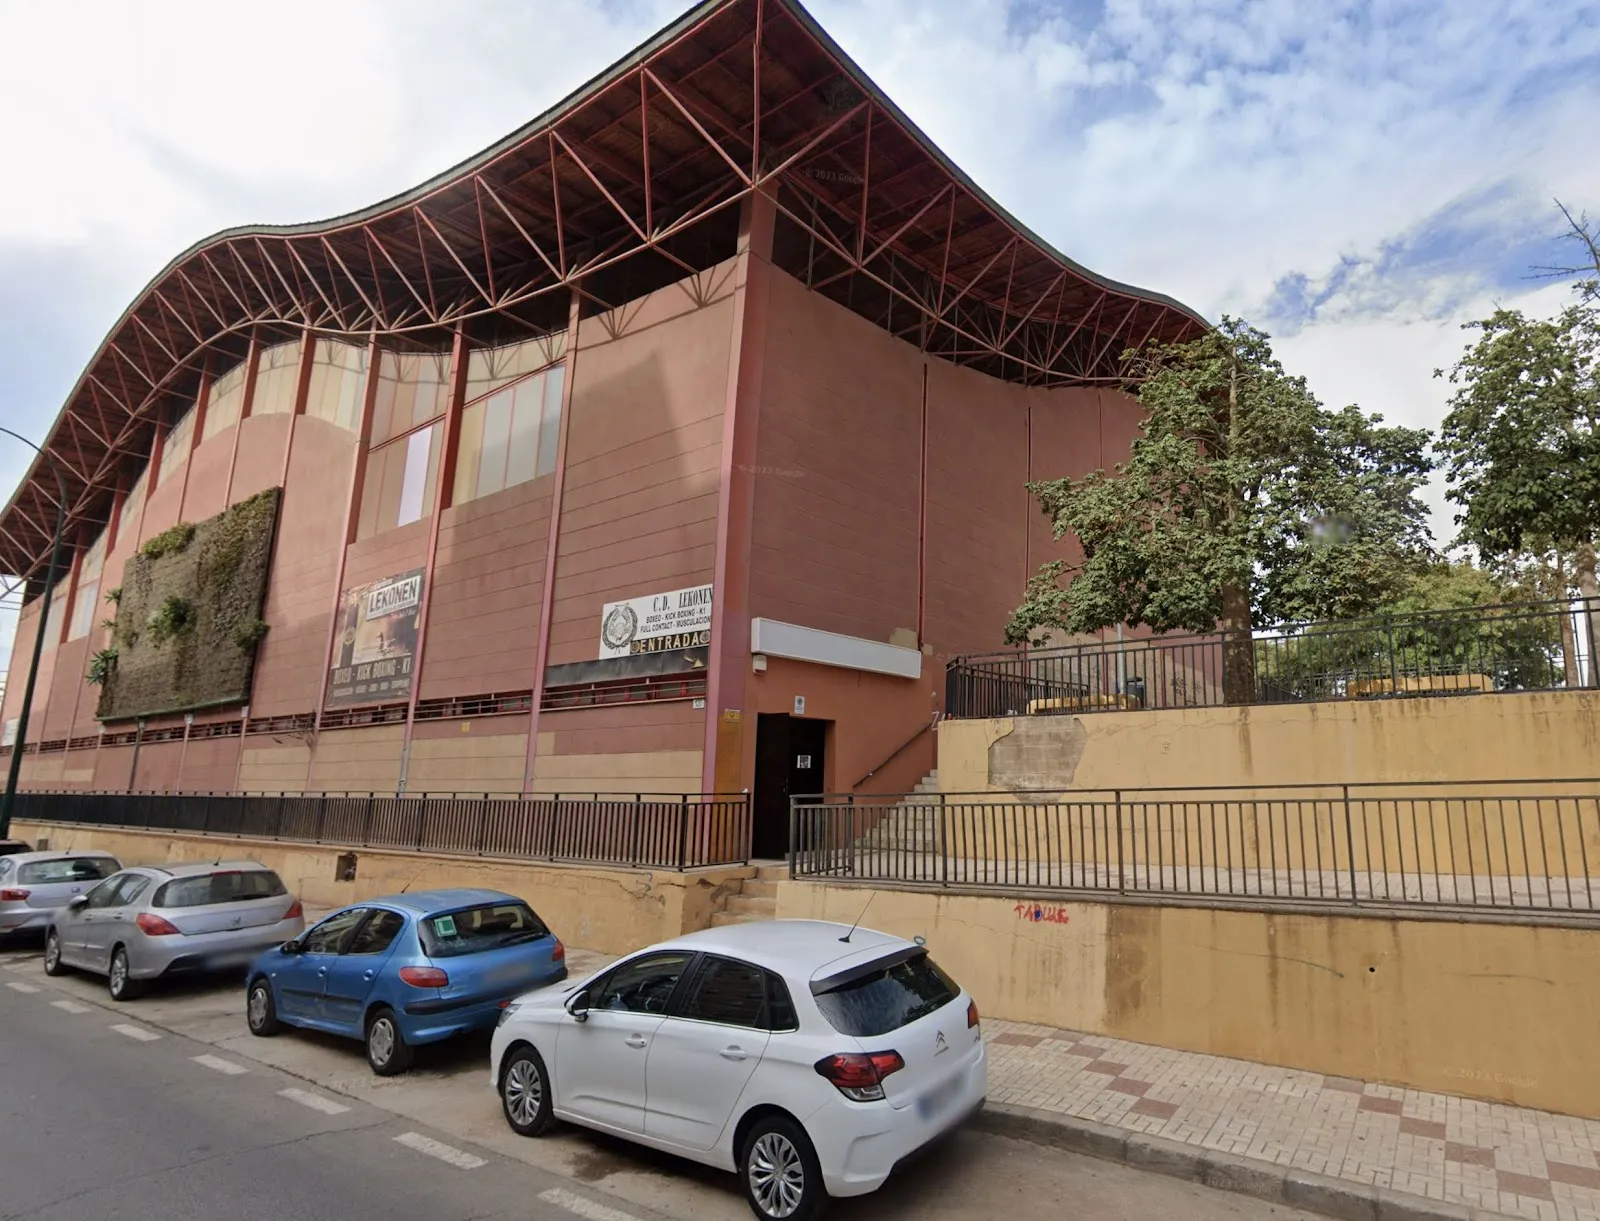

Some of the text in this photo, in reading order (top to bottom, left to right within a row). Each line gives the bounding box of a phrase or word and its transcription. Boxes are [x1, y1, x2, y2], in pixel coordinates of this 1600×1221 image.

[369, 578, 417, 612] LEKONEN
[646, 614, 661, 624] BOXEO
[665, 612, 676, 621] KICK
[677, 608, 695, 618] BOXING
[700, 607, 706, 615] K1
[640, 625, 651, 633] FULL
[652, 621, 673, 631] CONTACT
[639, 631, 700, 653] ENTRADA
[373, 659, 397, 679] BOXING
